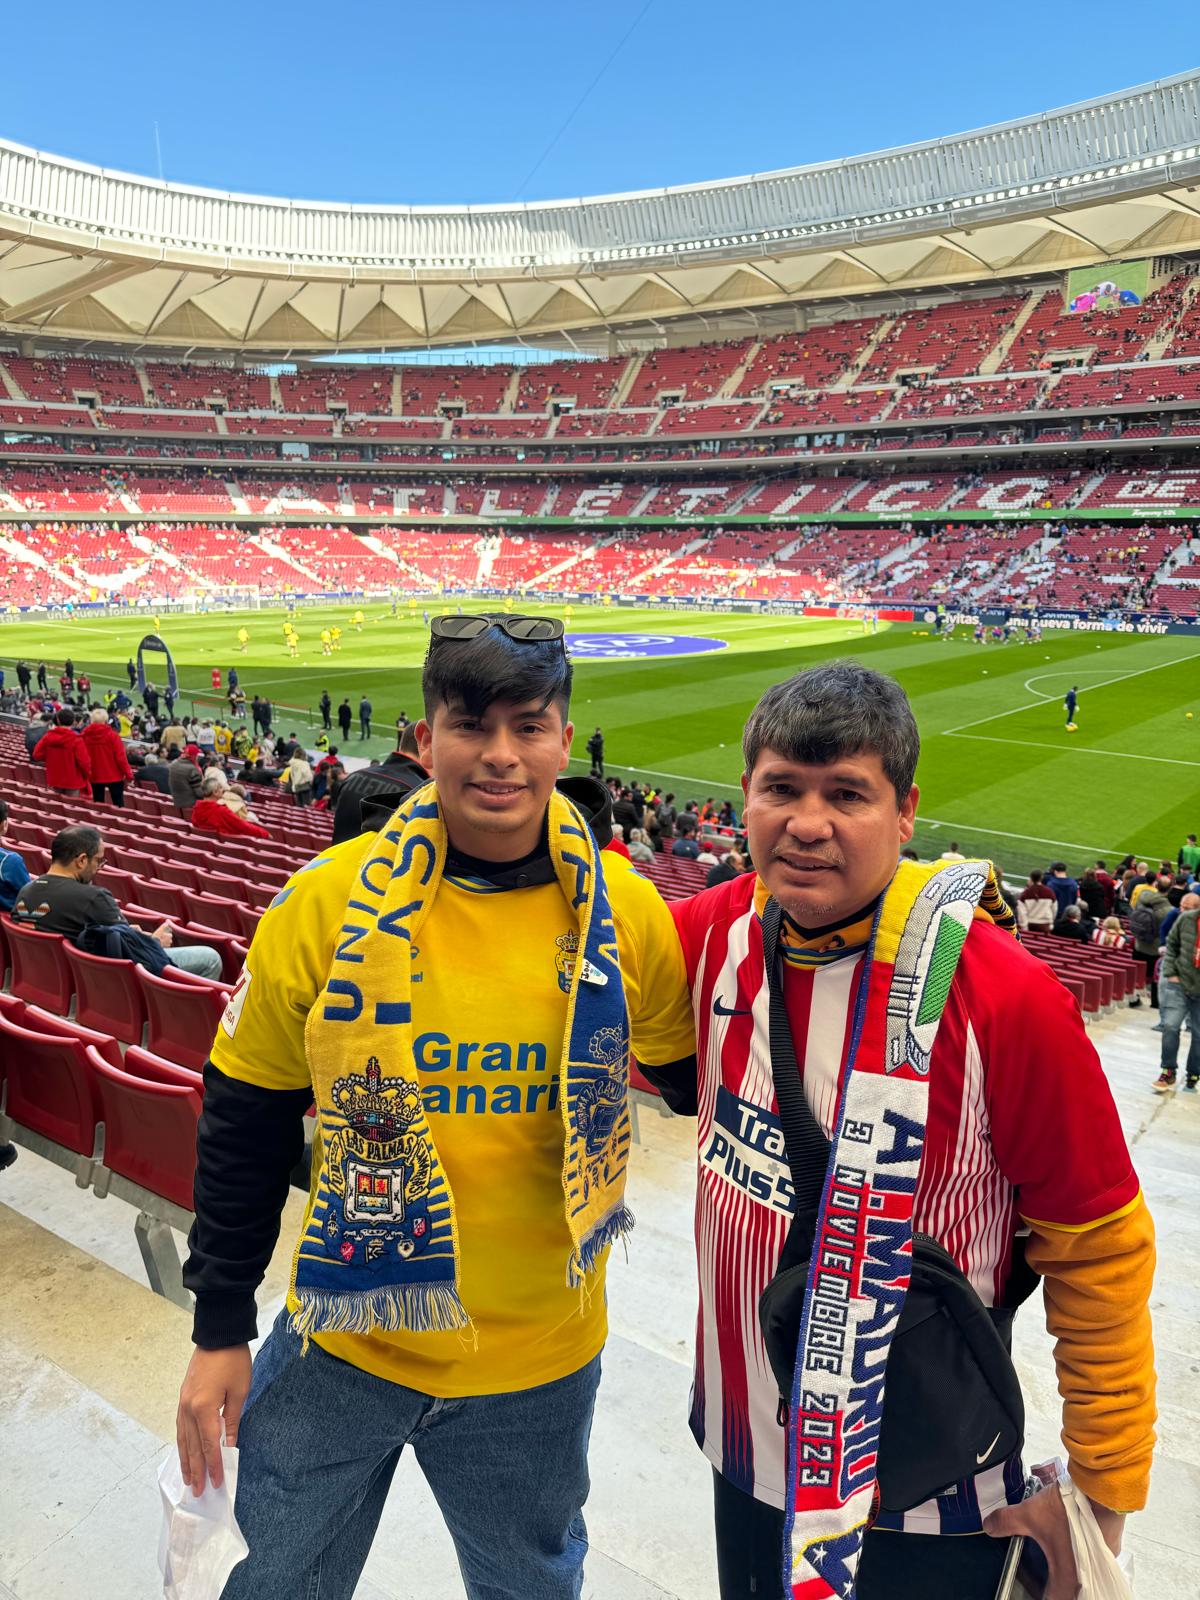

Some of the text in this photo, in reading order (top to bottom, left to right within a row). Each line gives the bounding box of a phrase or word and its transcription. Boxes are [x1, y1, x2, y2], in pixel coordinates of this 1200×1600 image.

[109, 606, 141, 617] forma
[144, 605, 157, 615] de
[1073, 618, 1113, 631] forma
[1115, 620, 1136, 632] de
[1136, 621, 1169, 634] vivir
[412, 1031, 548, 1073] Gran
[421, 1074, 561, 1115] anari
[345, 1129, 415, 1162] LAS PALMAS
[737, 1103, 787, 1158] Tra
[704, 1131, 798, 1214] Plus5
[799, 1118, 874, 1488] 3 NOVIEMBRE 2023
